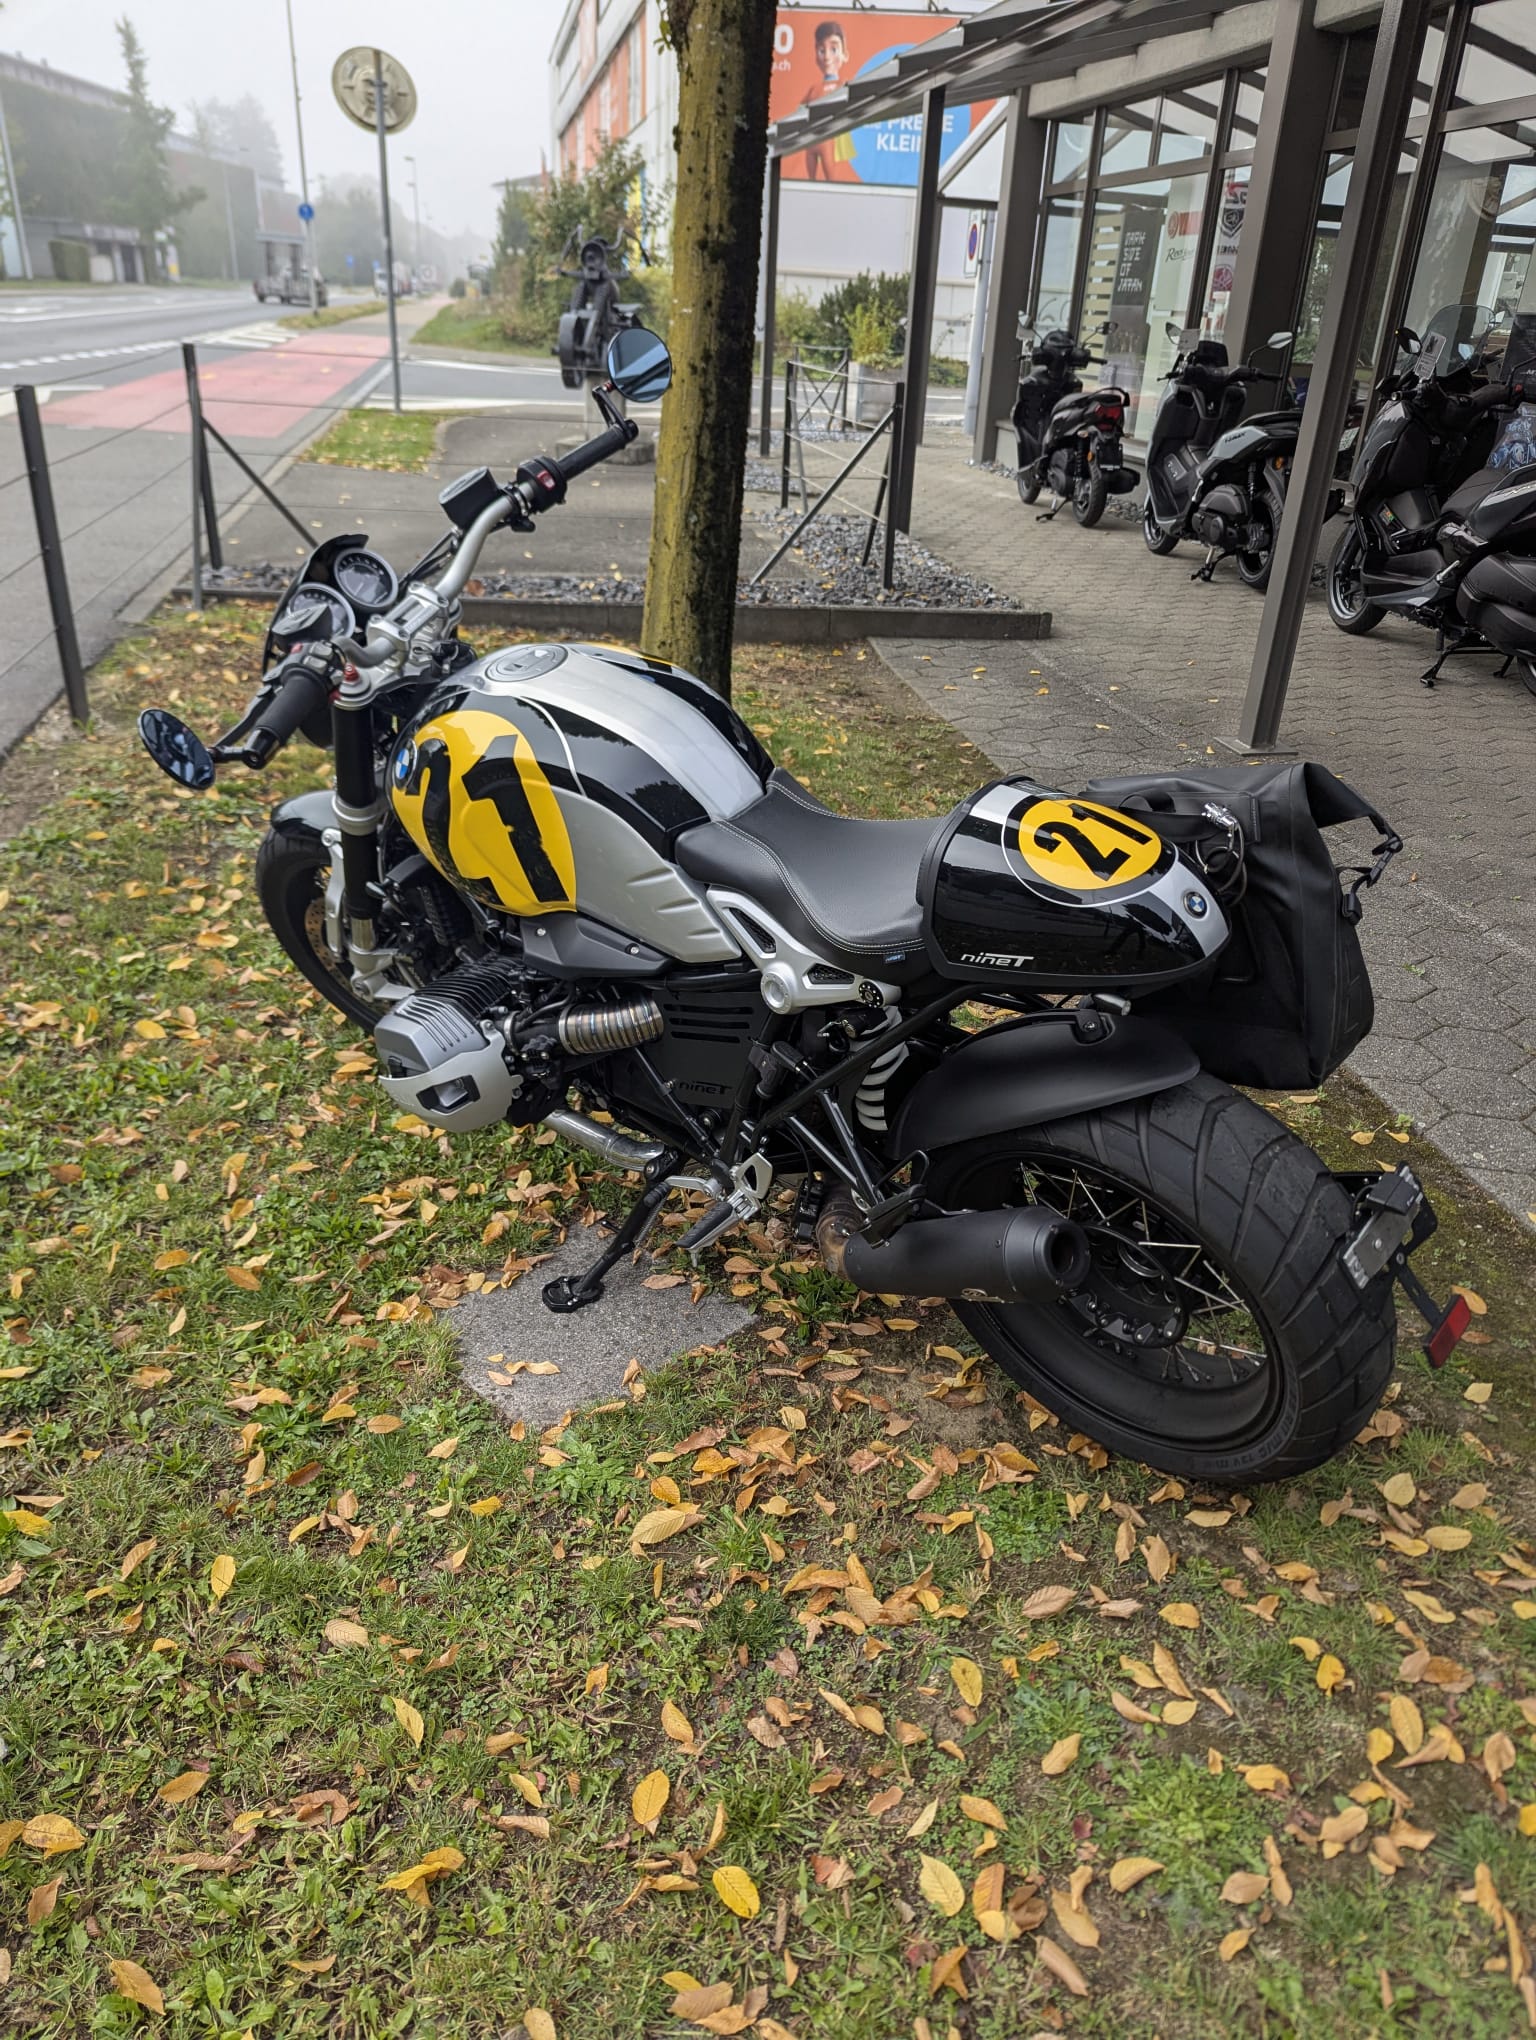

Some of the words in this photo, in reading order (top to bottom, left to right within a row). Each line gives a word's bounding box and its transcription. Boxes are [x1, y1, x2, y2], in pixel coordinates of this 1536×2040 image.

[405, 734, 569, 906] 21
[1034, 803, 1152, 882] 21
[961, 952, 1034, 967] nineT
[680, 1080, 733, 1094] nineT
